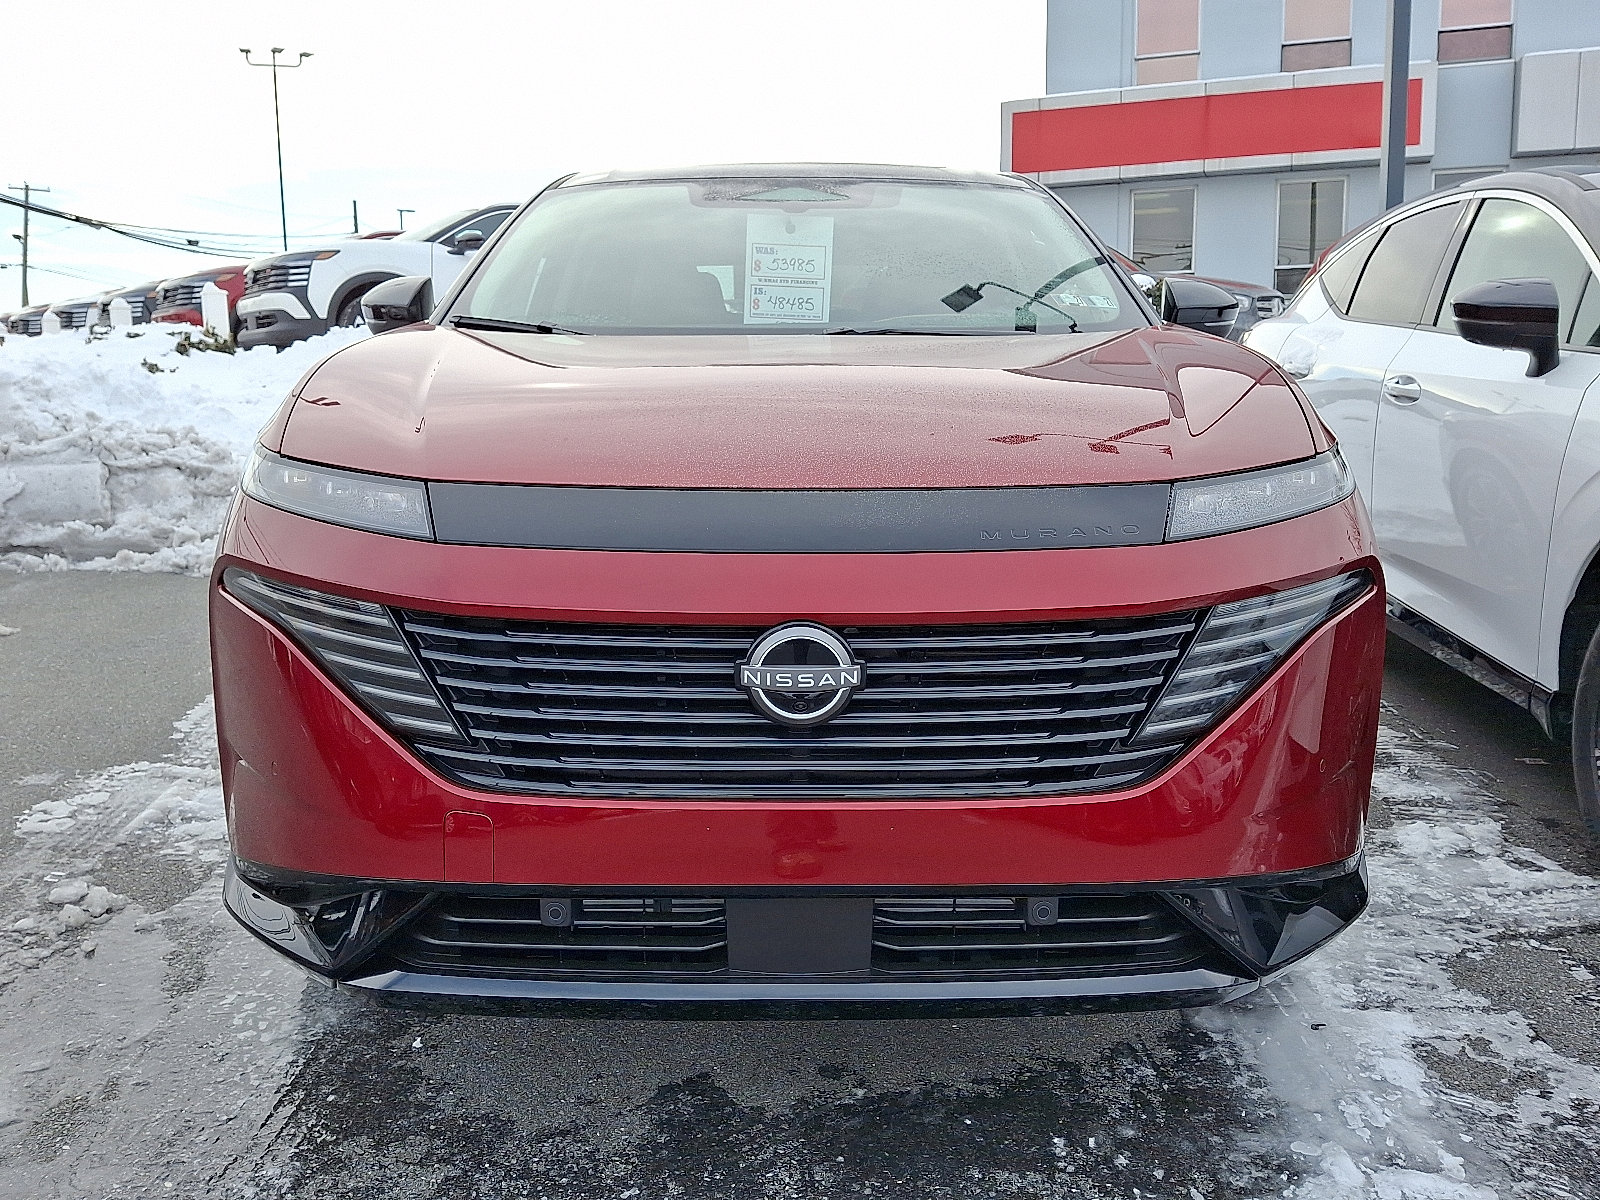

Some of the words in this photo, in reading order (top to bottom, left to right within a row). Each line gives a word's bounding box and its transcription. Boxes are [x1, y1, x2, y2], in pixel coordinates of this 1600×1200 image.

[755, 246, 778, 255] WAS:
[766, 257, 816, 273] 53985
[753, 287, 767, 295] IS:
[767, 295, 815, 311] 48485
[980, 524, 1140, 540] MURANO
[743, 670, 858, 688] NISSAN
